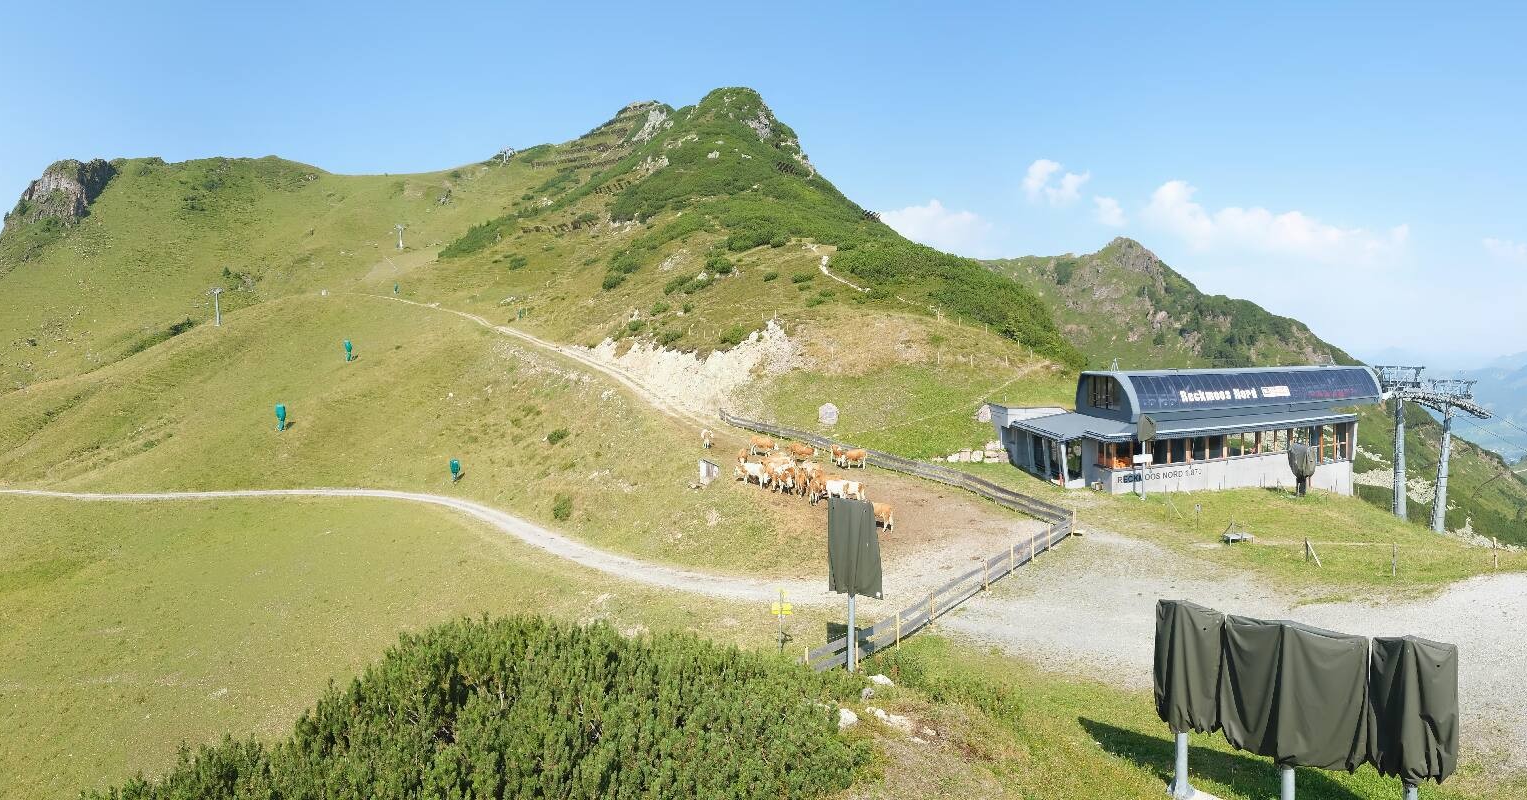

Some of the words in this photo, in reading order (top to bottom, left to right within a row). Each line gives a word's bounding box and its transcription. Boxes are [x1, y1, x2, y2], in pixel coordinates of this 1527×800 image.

[1179, 390, 1232, 402] Reckmoos
[1233, 387, 1258, 400] Nord
[1162, 470, 1183, 480] NORD
